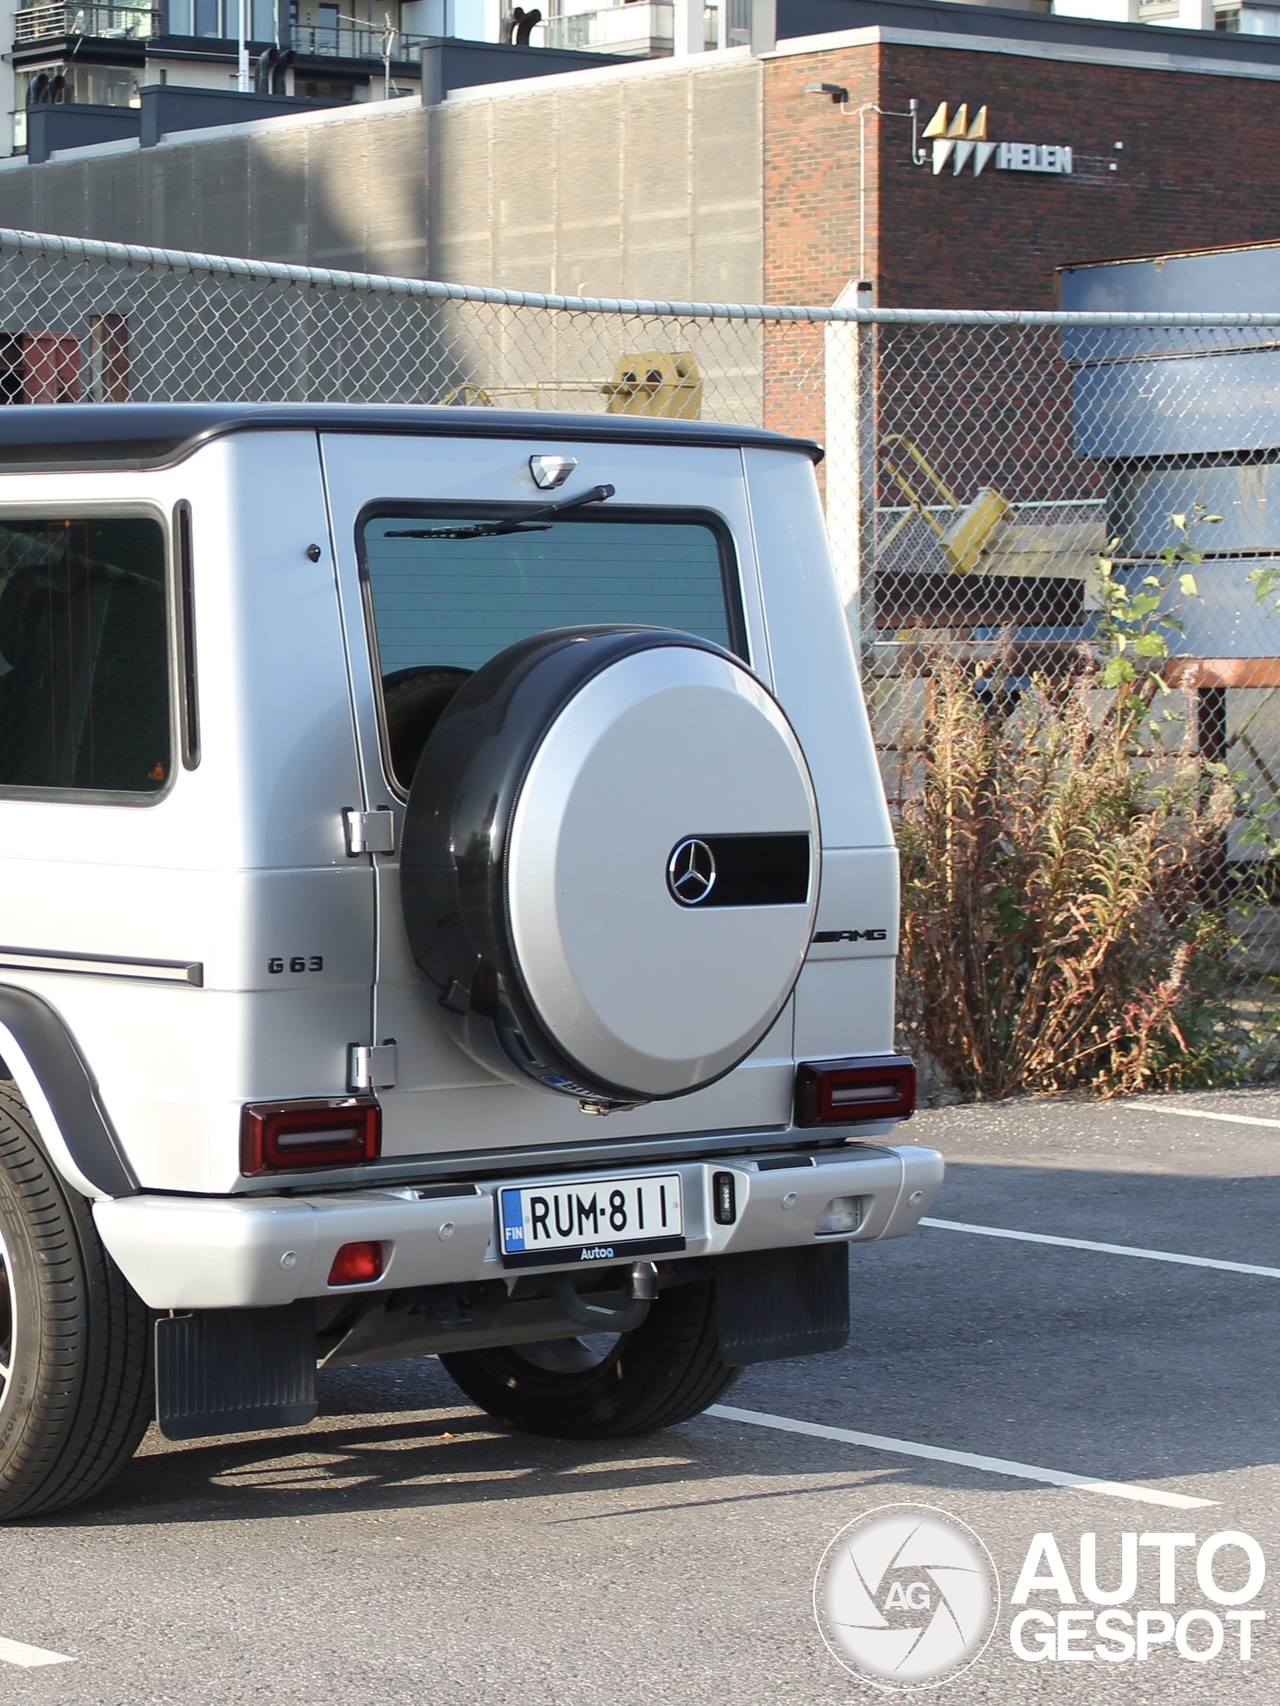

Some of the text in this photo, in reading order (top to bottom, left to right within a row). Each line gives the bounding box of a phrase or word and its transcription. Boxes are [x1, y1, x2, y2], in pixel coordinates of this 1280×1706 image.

[996, 142, 1072, 173] HELEN
[838, 929, 888, 942] AMG
[268, 955, 323, 974] G 63
[505, 1185, 667, 1241] FIN RUM-811
